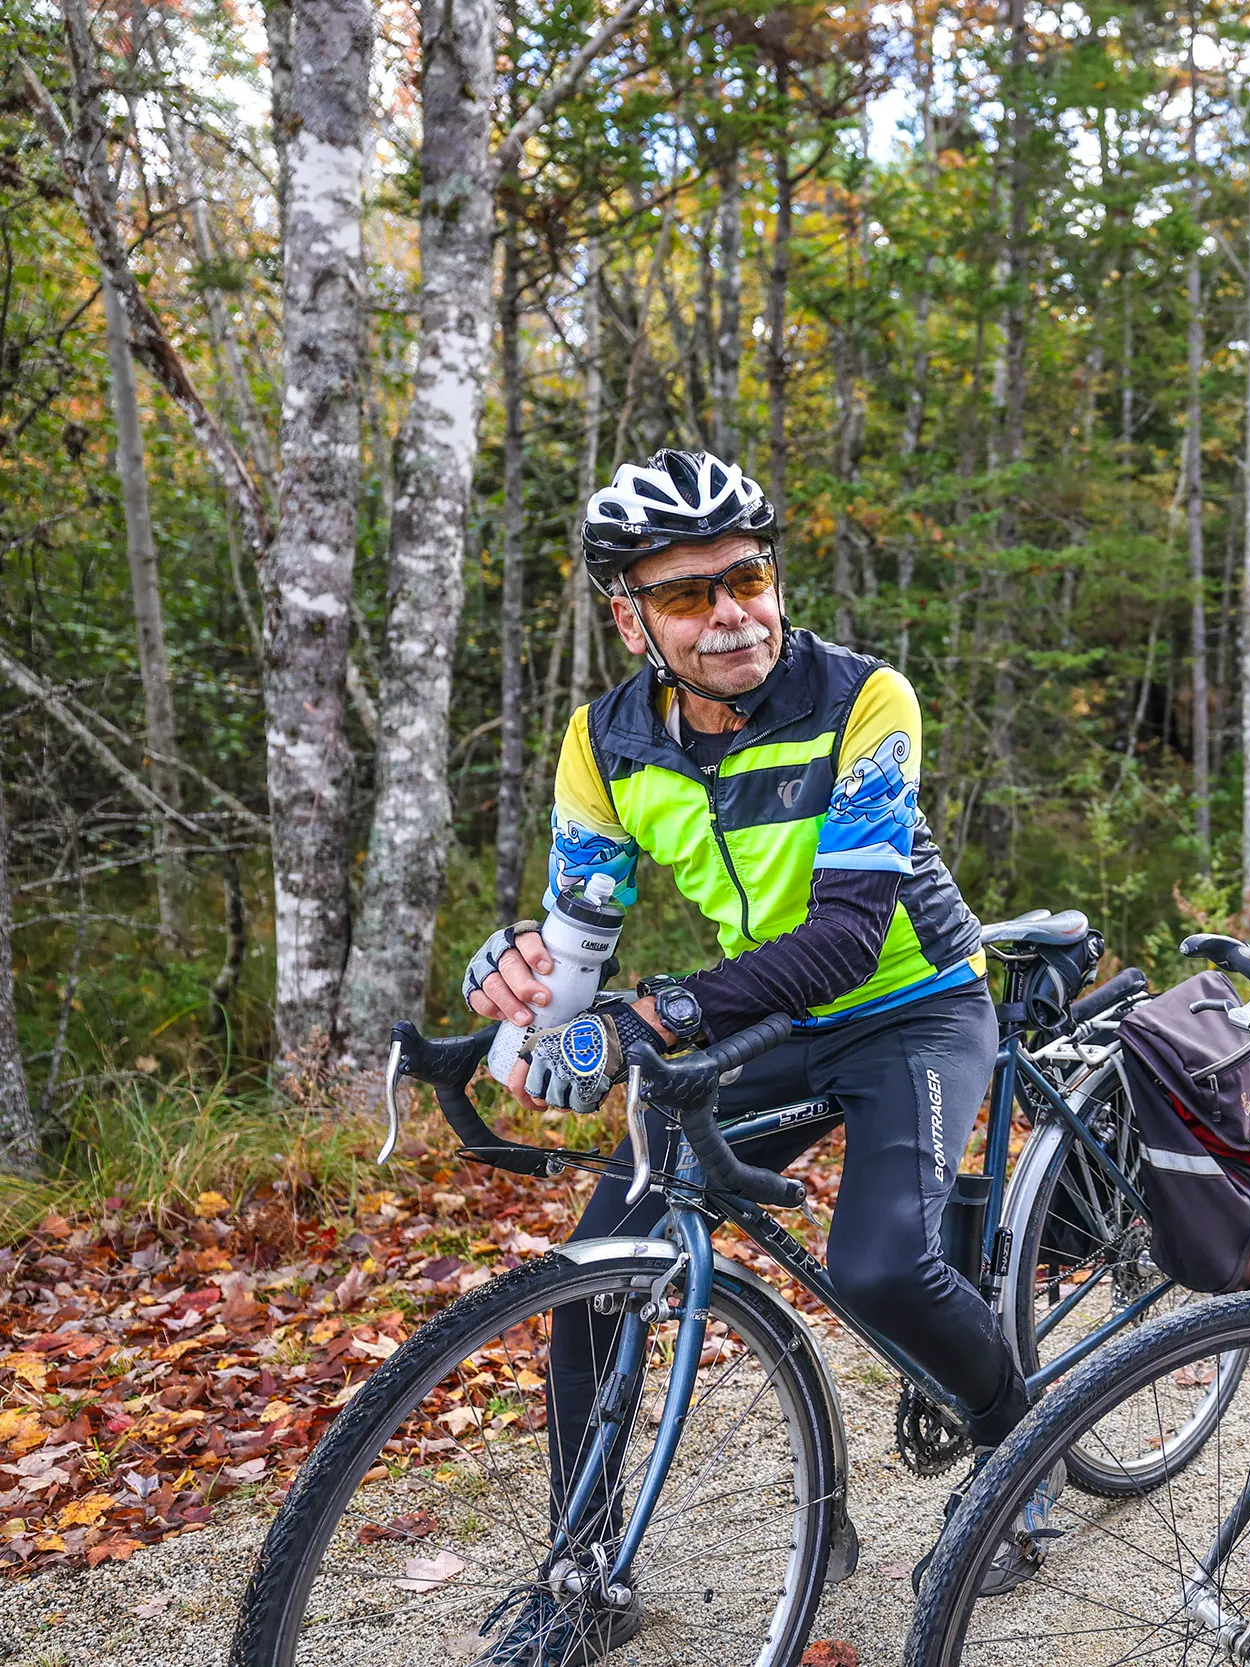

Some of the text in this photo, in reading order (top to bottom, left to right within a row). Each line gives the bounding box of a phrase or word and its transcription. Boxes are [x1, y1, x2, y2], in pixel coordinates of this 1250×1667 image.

[779, 1100, 830, 1127] 520
[926, 1069, 946, 1183] BONTRAGER
[1000, 1235, 1012, 1273] LEZYNE
[740, 1289, 766, 1312] PLUS
